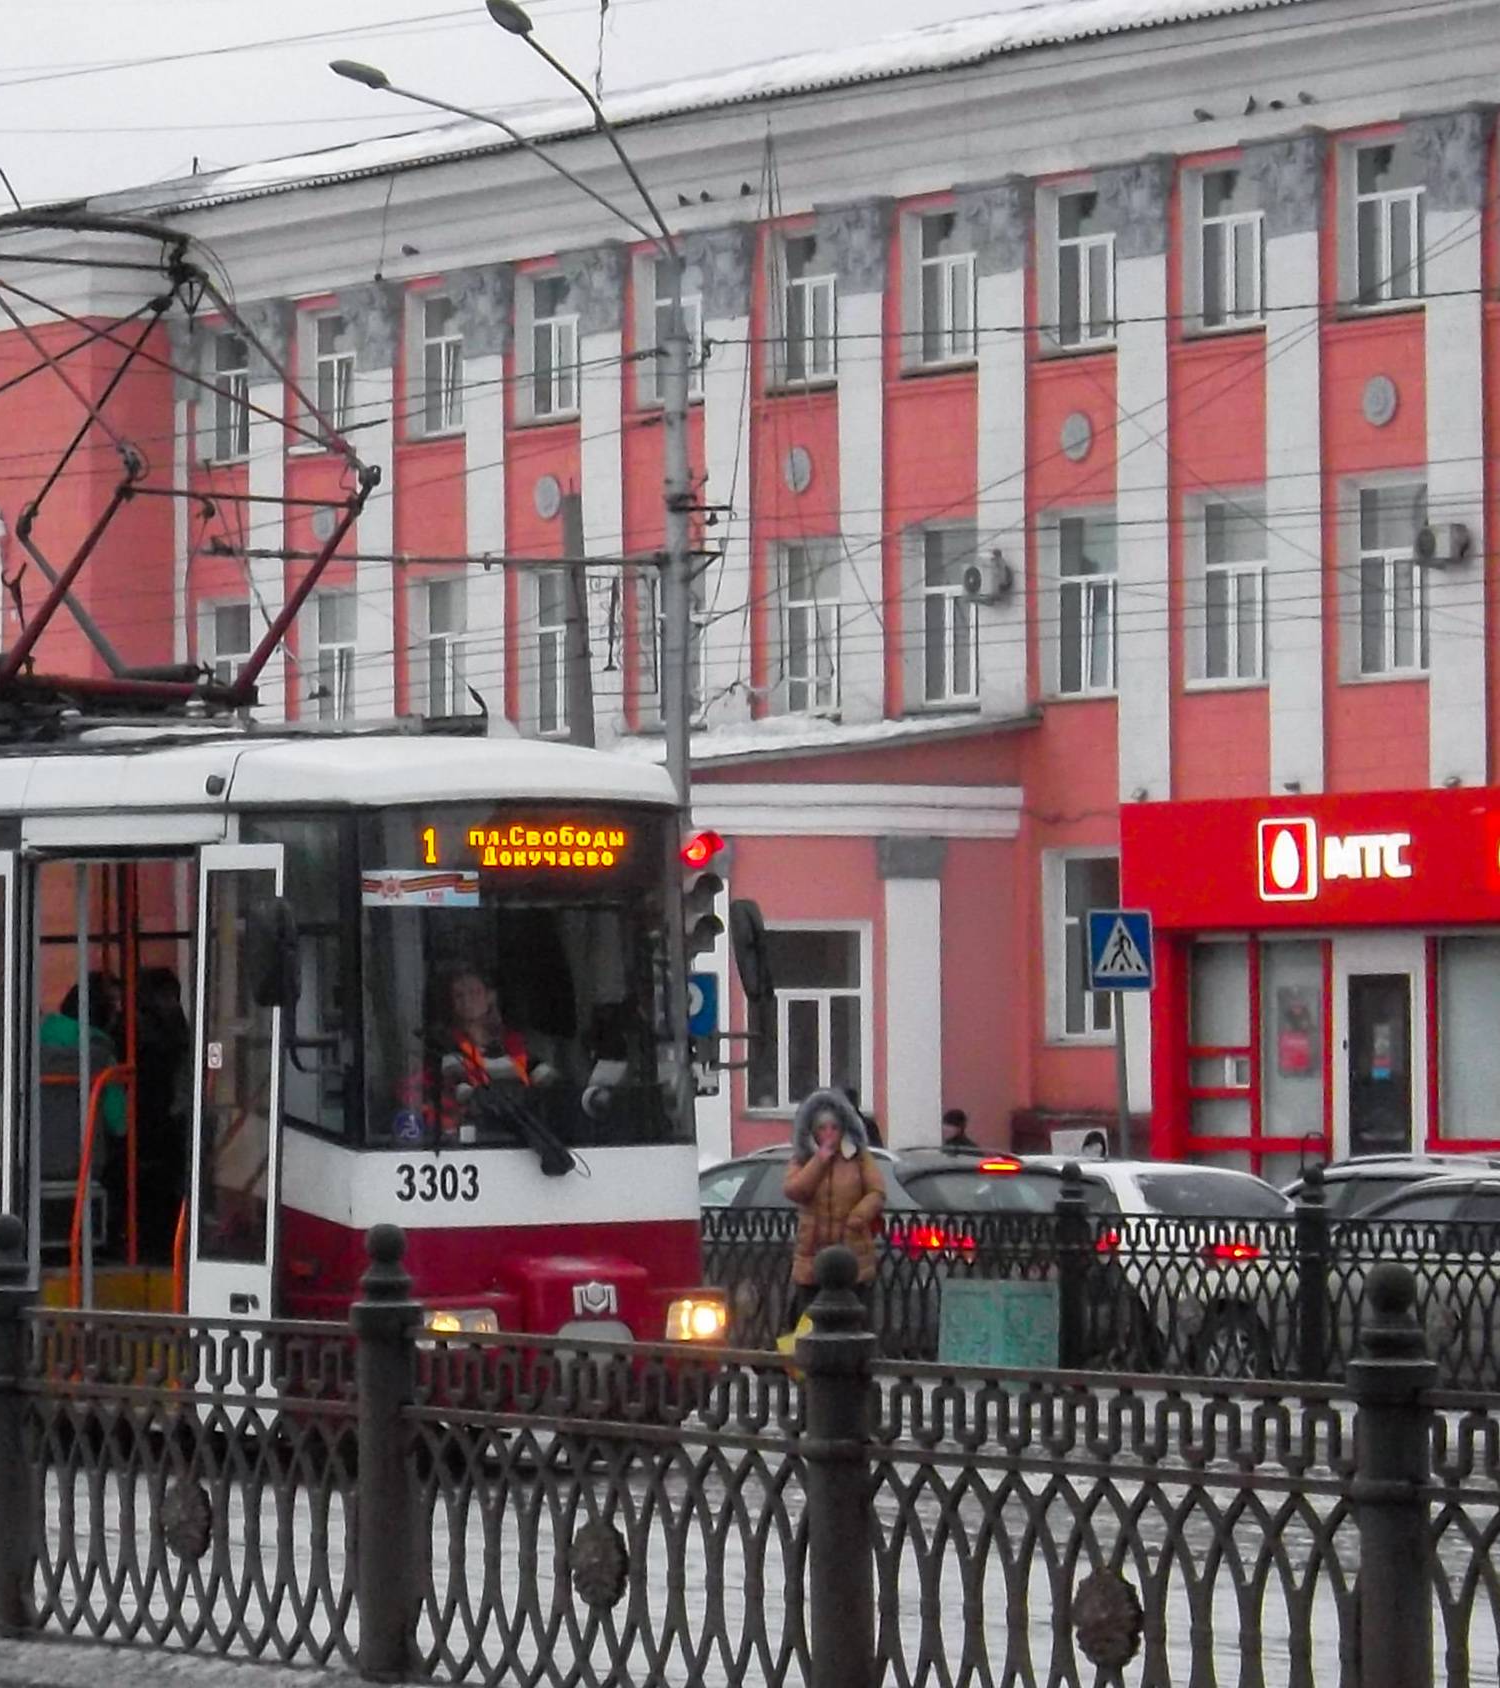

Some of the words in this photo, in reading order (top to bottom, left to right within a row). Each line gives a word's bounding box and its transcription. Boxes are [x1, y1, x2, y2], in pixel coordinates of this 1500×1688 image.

[423, 827, 437, 864] 1
[468, 826, 625, 848] пл.Свободы
[482, 846, 615, 866] Докучаево
[1323, 832, 1412, 880] МТС
[396, 1163, 480, 1202] 3303
